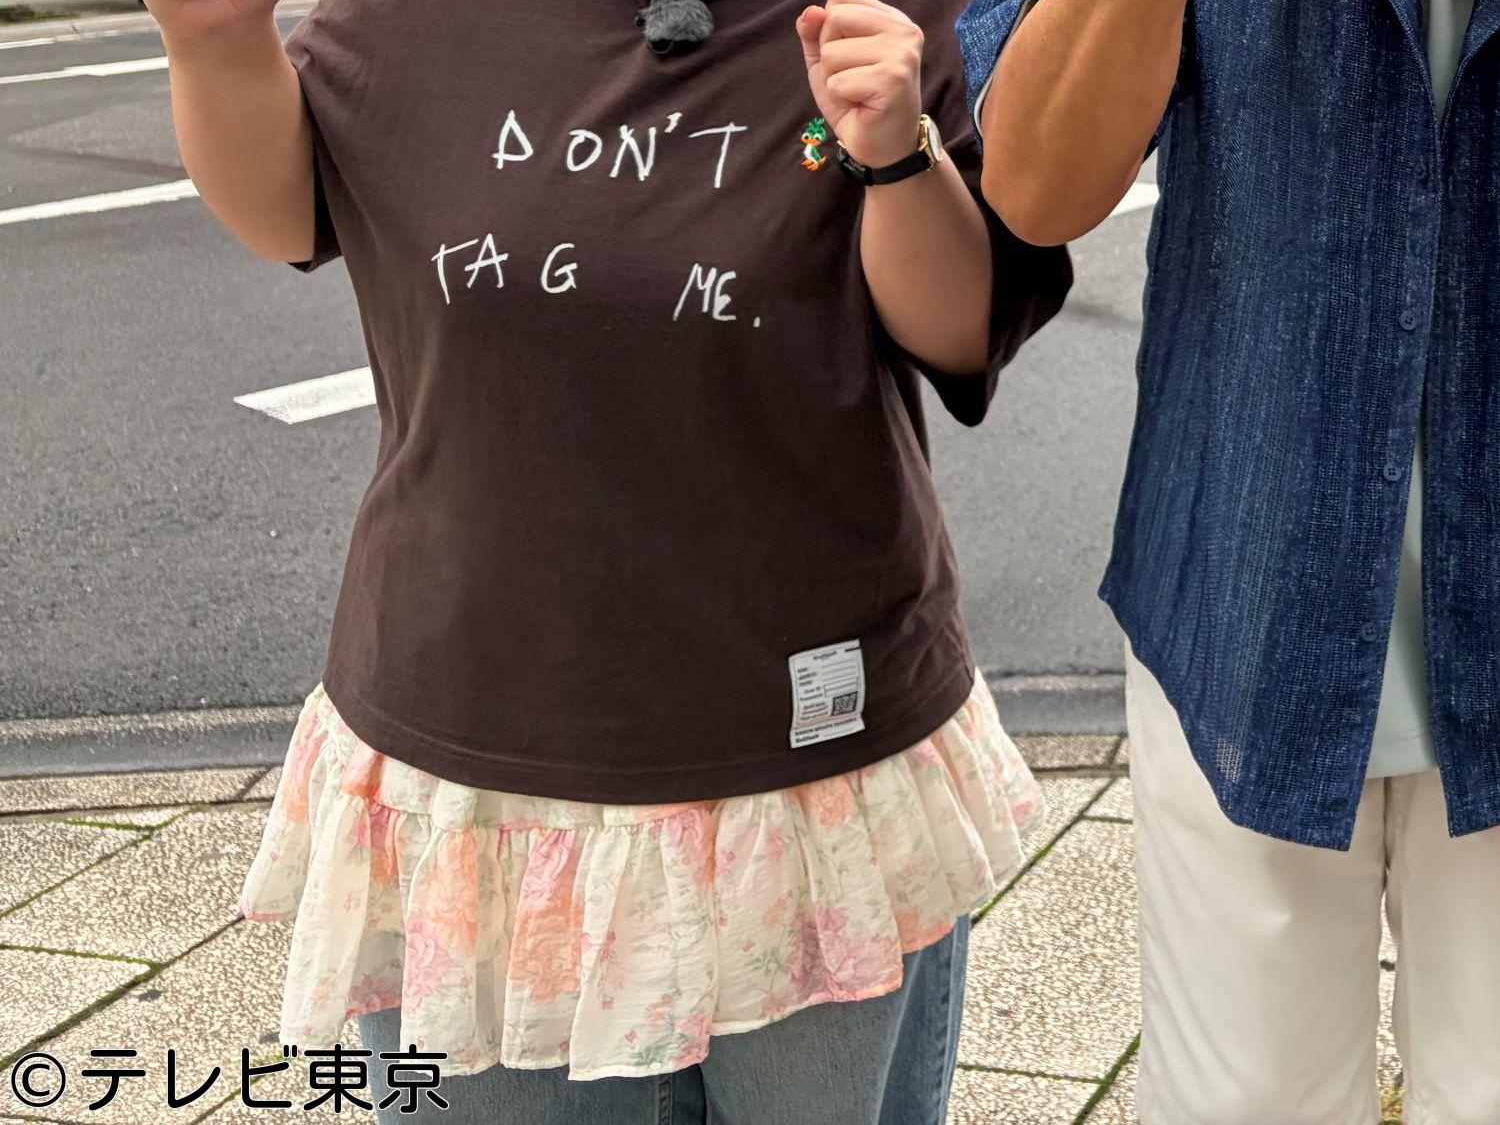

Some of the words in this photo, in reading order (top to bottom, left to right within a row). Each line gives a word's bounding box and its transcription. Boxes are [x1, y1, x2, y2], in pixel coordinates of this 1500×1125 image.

[492, 109, 748, 188] DON'T
[431, 233, 578, 305] TAG
[672, 262, 761, 327] ME.
